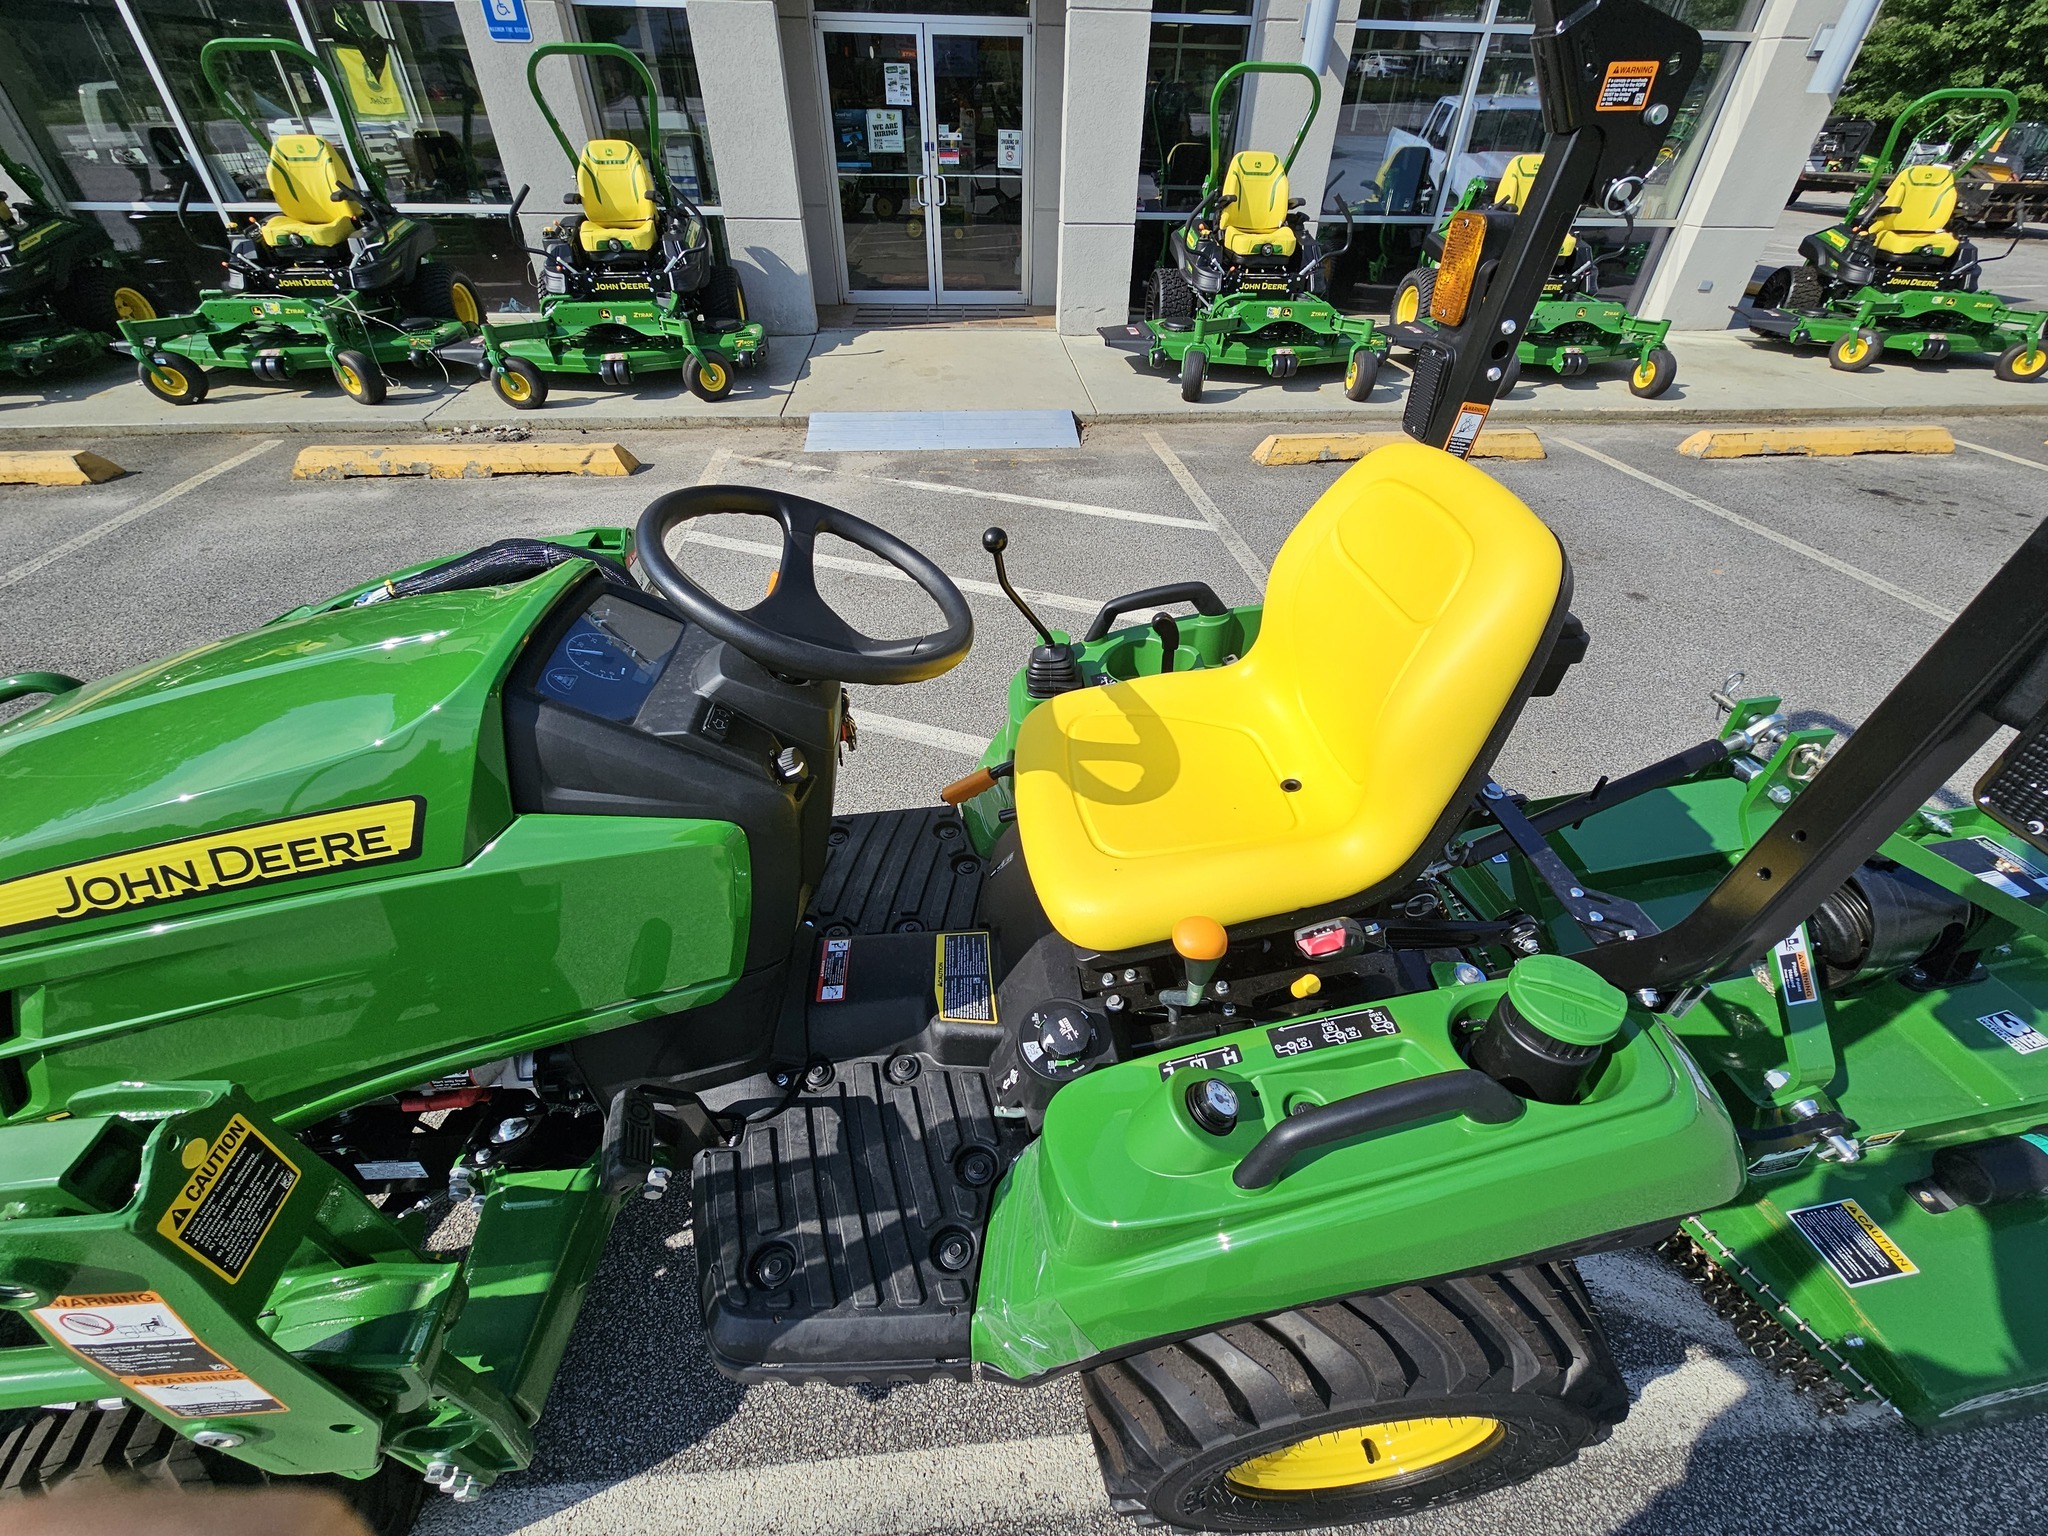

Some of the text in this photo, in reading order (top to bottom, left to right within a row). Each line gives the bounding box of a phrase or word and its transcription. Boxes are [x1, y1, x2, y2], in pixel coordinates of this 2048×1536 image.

[278, 278, 334, 287] JOHN DEERE
[595, 282, 620, 290] JOHN
[1262, 282, 1287, 290] DEERE
[1887, 277, 1939, 287] JOHN DEERE
[56, 825, 392, 914] JOHN DEERE
[1788, 969, 1796, 988] Hazard
[1791, 961, 1799, 977] Pinch
[1800, 960, 1812, 997] WARNING
[1988, 1012, 2035, 1037] 3
[1222, 1051, 1238, 1065] H
[184, 1119, 246, 1204] CAUTION
[186, 1145, 247, 1235] Lock loader latches before
[195, 1152, 255, 1242] Before servicing, adjusting
[208, 1164, 265, 1251] A) Lower loader to ground
[216, 1161, 278, 1258] B) Shut off engine and relieve
[191, 1201, 217, 1239] operating.
[200, 1207, 226, 1245] equipment
[225, 1198, 232, 1207] or
[218, 1179, 261, 1246] or support lift arms.
[226, 1188, 268, 1252] hydraulic pressure.
[204, 1237, 212, 1248] oil
[225, 1233, 245, 1264] Observe
[244, 1211, 259, 1234] safety
[229, 1217, 260, 1266] tions in loader
[233, 1206, 273, 1270] operator's manual.
[1856, 1215, 1909, 1266] CAUTION
[50, 1293, 157, 1307] WARNING
[145, 1374, 241, 1384] WARNING
